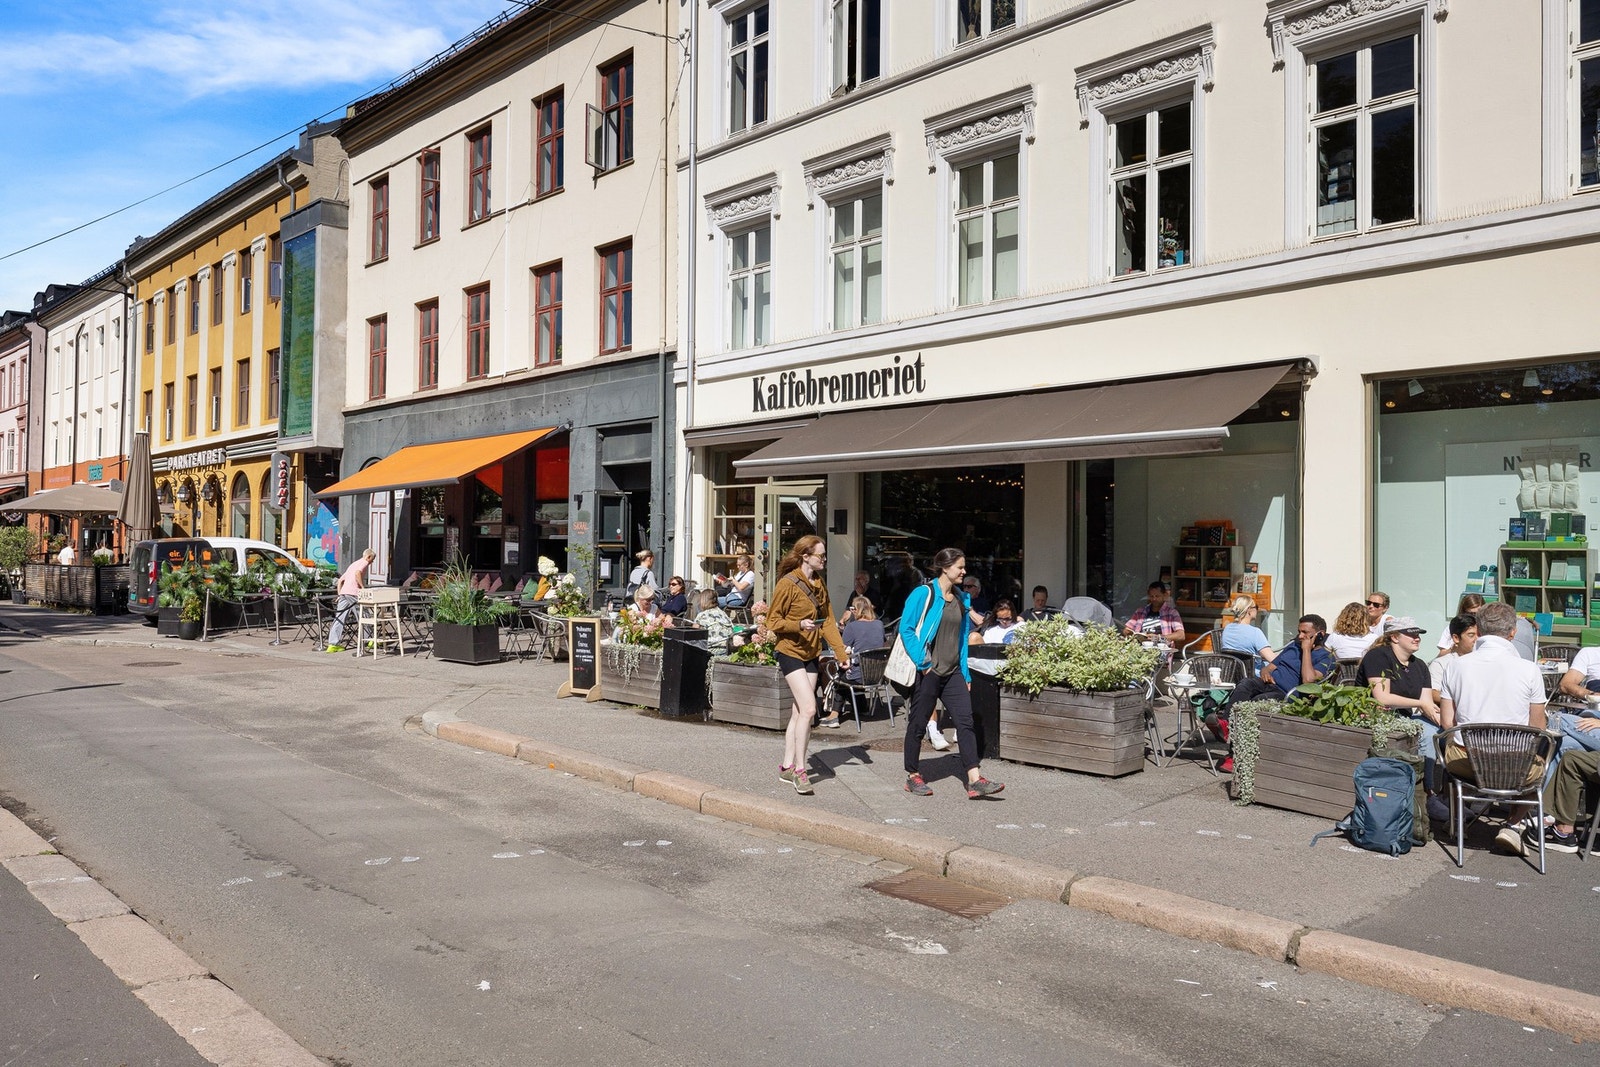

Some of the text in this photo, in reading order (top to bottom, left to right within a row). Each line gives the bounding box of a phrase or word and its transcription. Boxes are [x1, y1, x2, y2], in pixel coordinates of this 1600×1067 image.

[752, 352, 926, 413] Kaffebrenneriet
[167, 448, 224, 471] PARKTEATRET
[277, 459, 288, 507] SCENE
